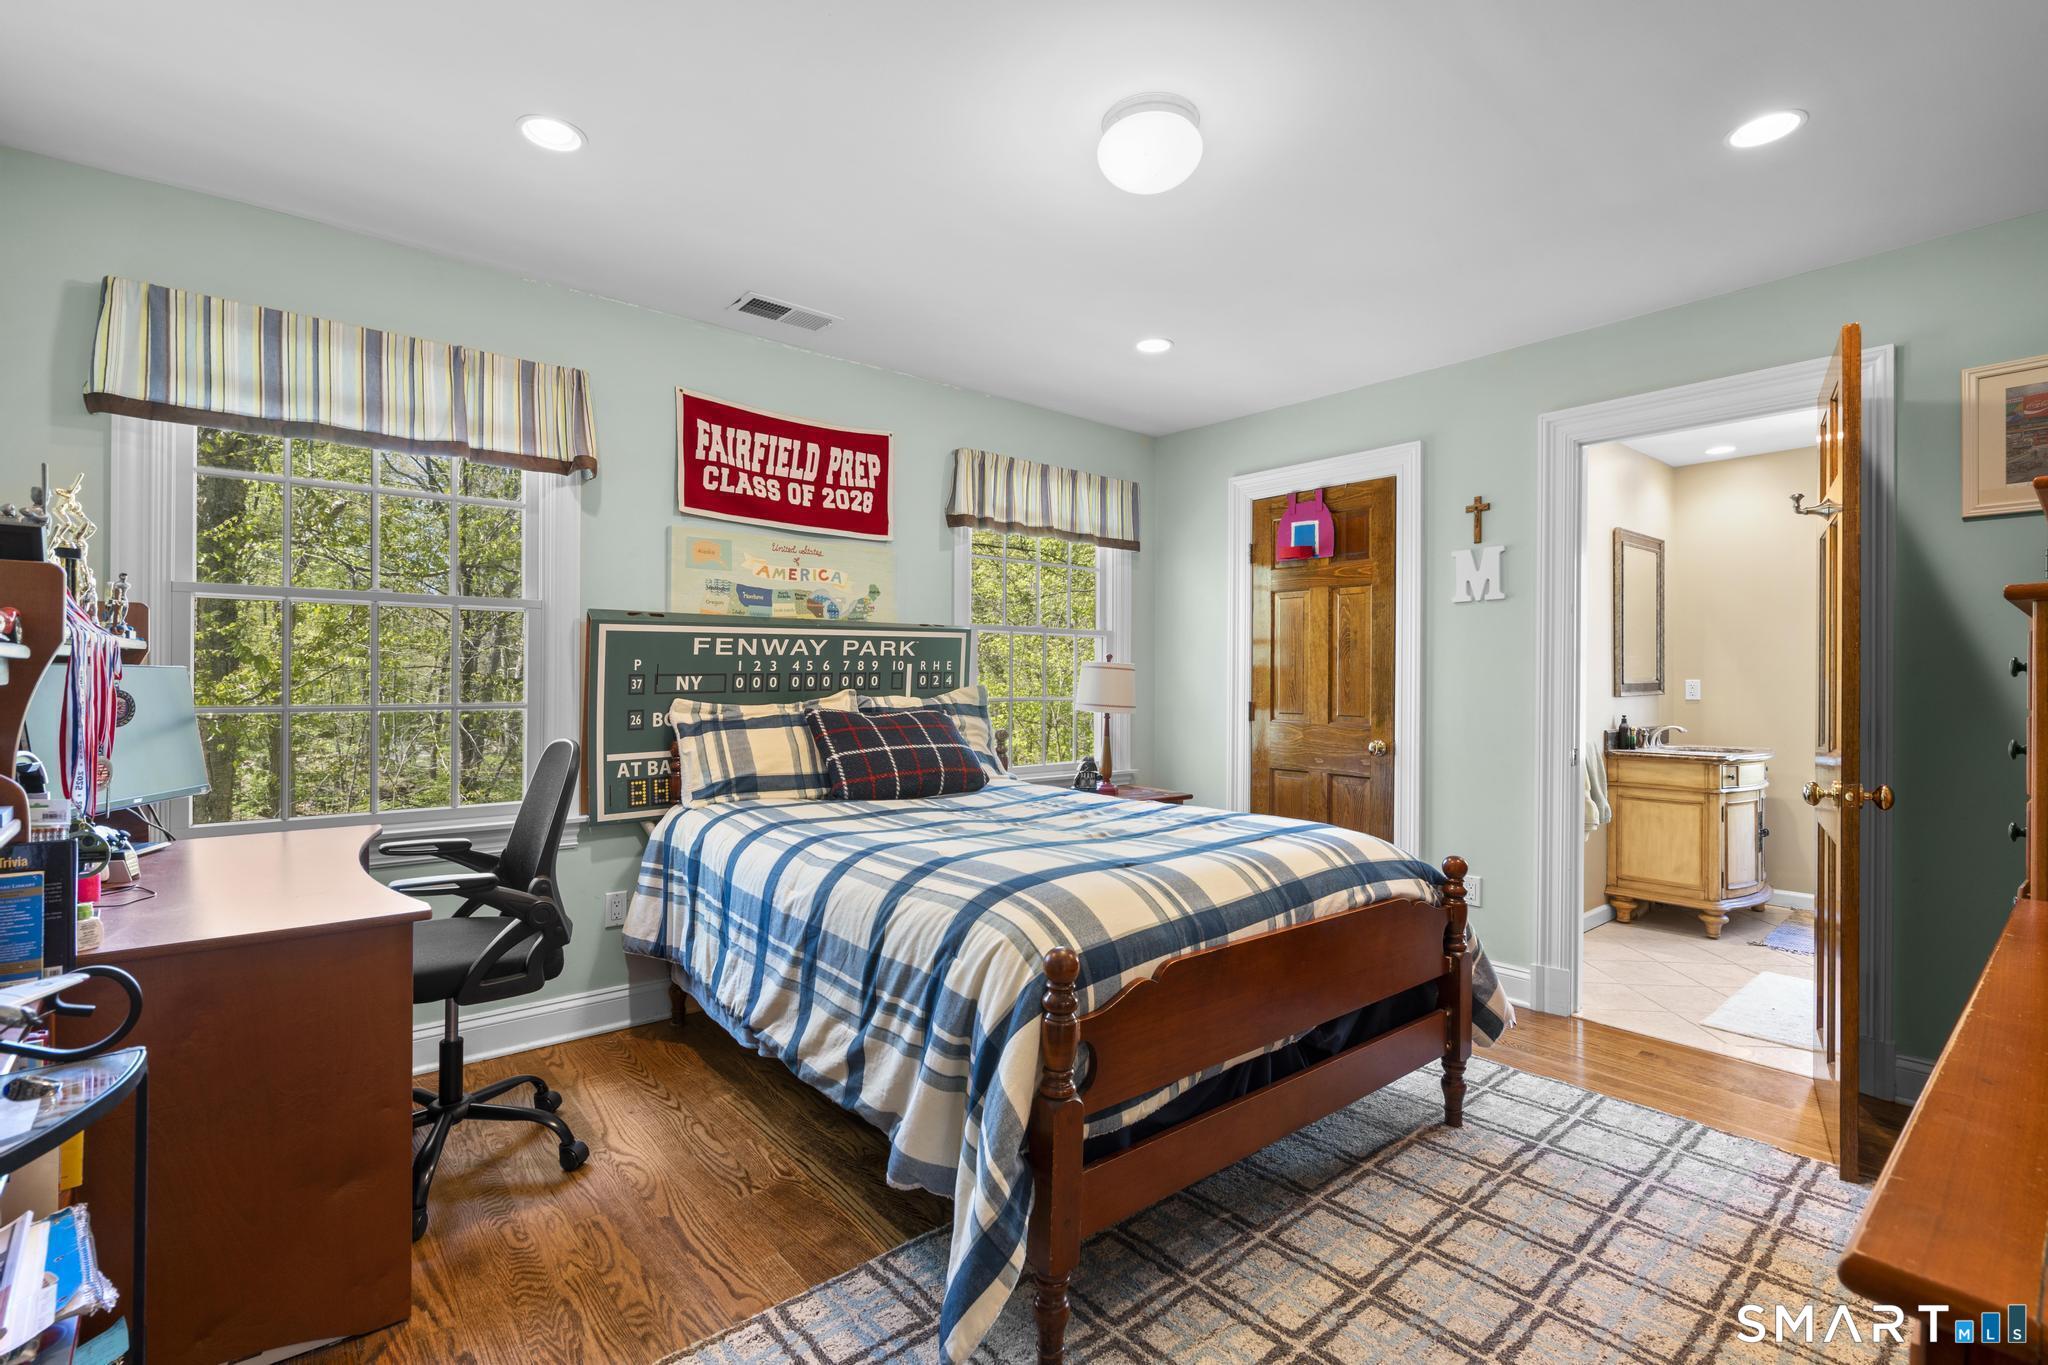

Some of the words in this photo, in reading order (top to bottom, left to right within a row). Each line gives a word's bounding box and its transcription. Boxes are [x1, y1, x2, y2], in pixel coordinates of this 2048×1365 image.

[695, 418, 820, 482] FAIRFIELD
[826, 446, 881, 489] PREP
[702, 465, 781, 501] CLASS
[787, 482, 815, 507] OF
[821, 487, 874, 514] 2028
[755, 565, 842, 584] AMERICA
[1451, 545, 1505, 602] M
[693, 637, 829, 657] FENWAY
[842, 640, 916, 657] PARK
[634, 659, 642, 671] P
[738, 660, 742, 672] 1
[753, 660, 761, 672] 2
[769, 660, 777, 672] 3
[792, 660, 800, 671] 4
[806, 660, 813, 671] 5
[822, 660, 830, 671] 6
[843, 660, 850, 671] 7
[857, 660, 865, 671] 8
[871, 660, 879, 671] 9
[892, 660, 904, 671] 10
[920, 660, 926, 671] R
[932, 660, 940, 671] H
[946, 660, 952, 671] E
[631, 679, 643, 690] 37
[675, 675, 703, 691] NY
[933, 675, 940, 686] 2
[945, 675, 952, 685] 4
[630, 715, 642, 726] 26
[617, 761, 642, 779] AT
[647, 759, 672, 776] BA
